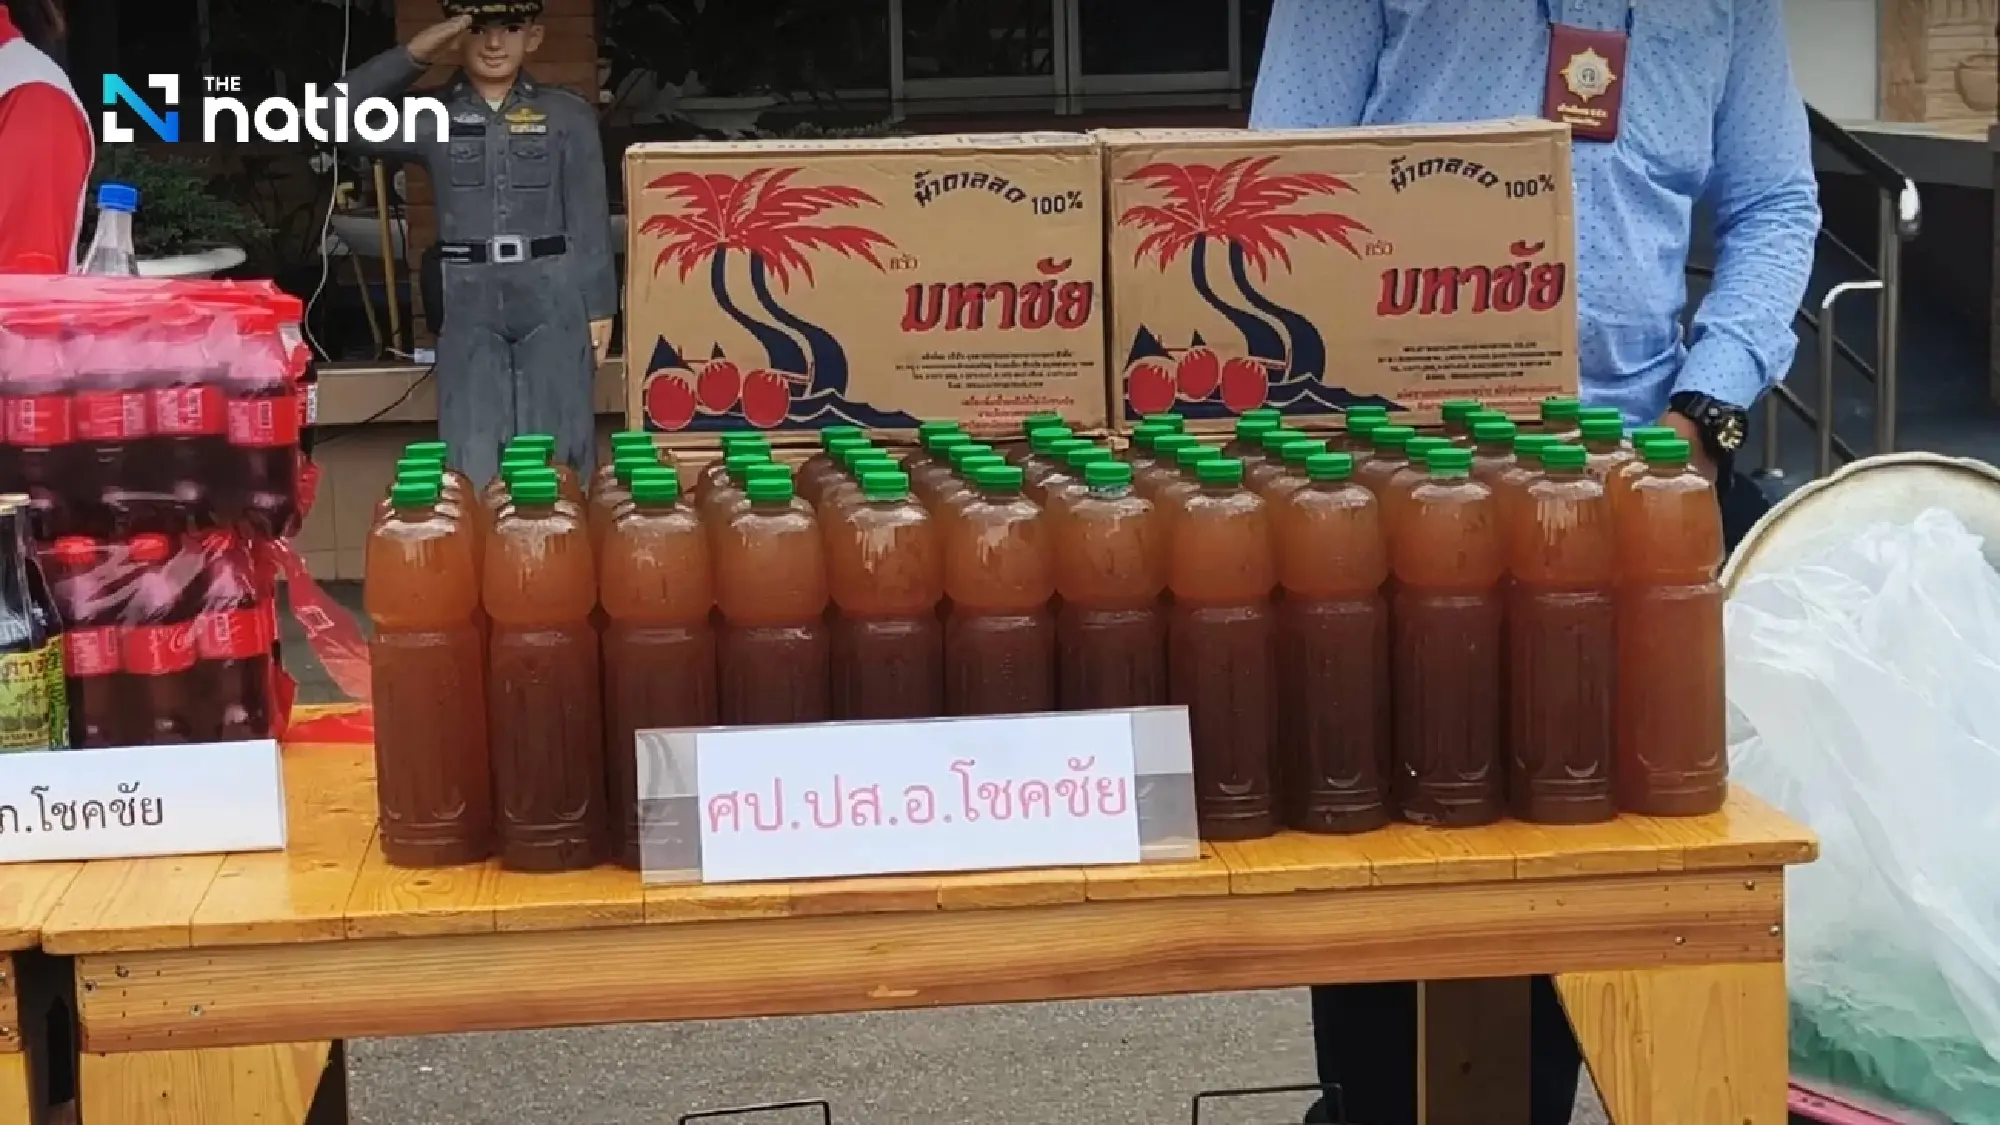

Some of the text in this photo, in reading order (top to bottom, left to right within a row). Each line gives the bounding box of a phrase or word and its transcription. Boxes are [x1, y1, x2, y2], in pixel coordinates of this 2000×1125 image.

[914, 168, 1084, 215] น้ำตาลสด 100%
[1390, 155, 1555, 199] น้ำตาลสด 100%
[901, 256, 1094, 332] มหาชัย
[1376, 239, 1566, 316] มหาชัย
[707, 755, 1128, 833] ศป.ปส.อ.โชคชัย
